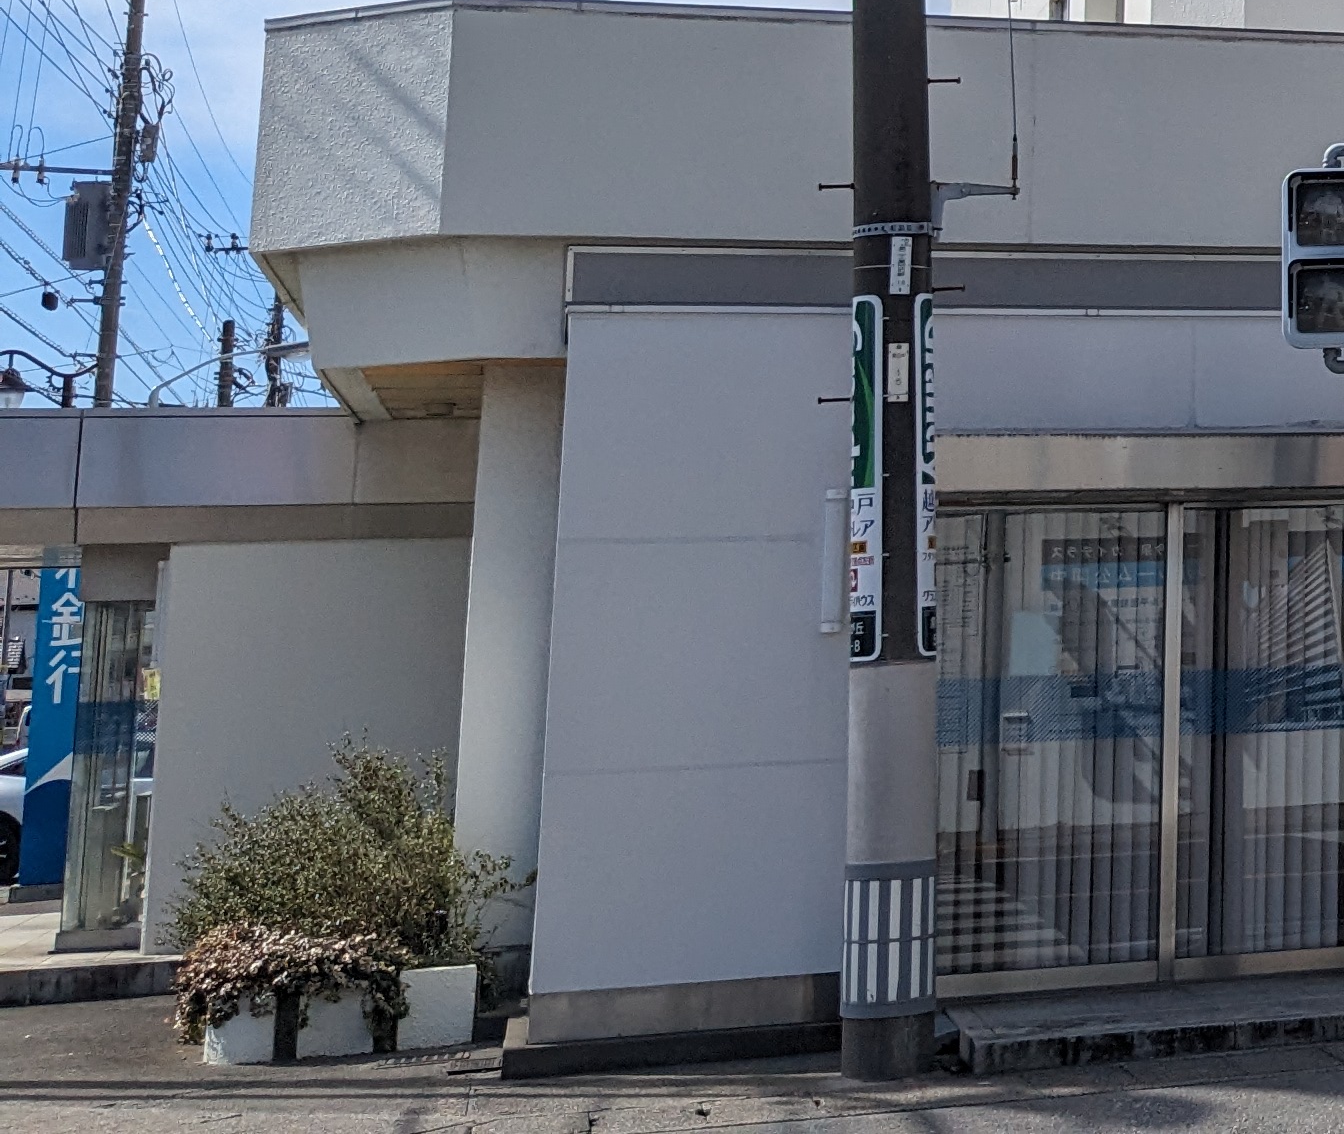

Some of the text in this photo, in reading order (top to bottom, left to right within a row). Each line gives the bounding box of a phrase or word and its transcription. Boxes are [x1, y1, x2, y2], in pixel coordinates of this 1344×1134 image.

[851, 493, 875, 516] 戸
[851, 519, 875, 537] レア
[922, 513, 936, 533] ア
[46, 568, 83, 704] 銀行
